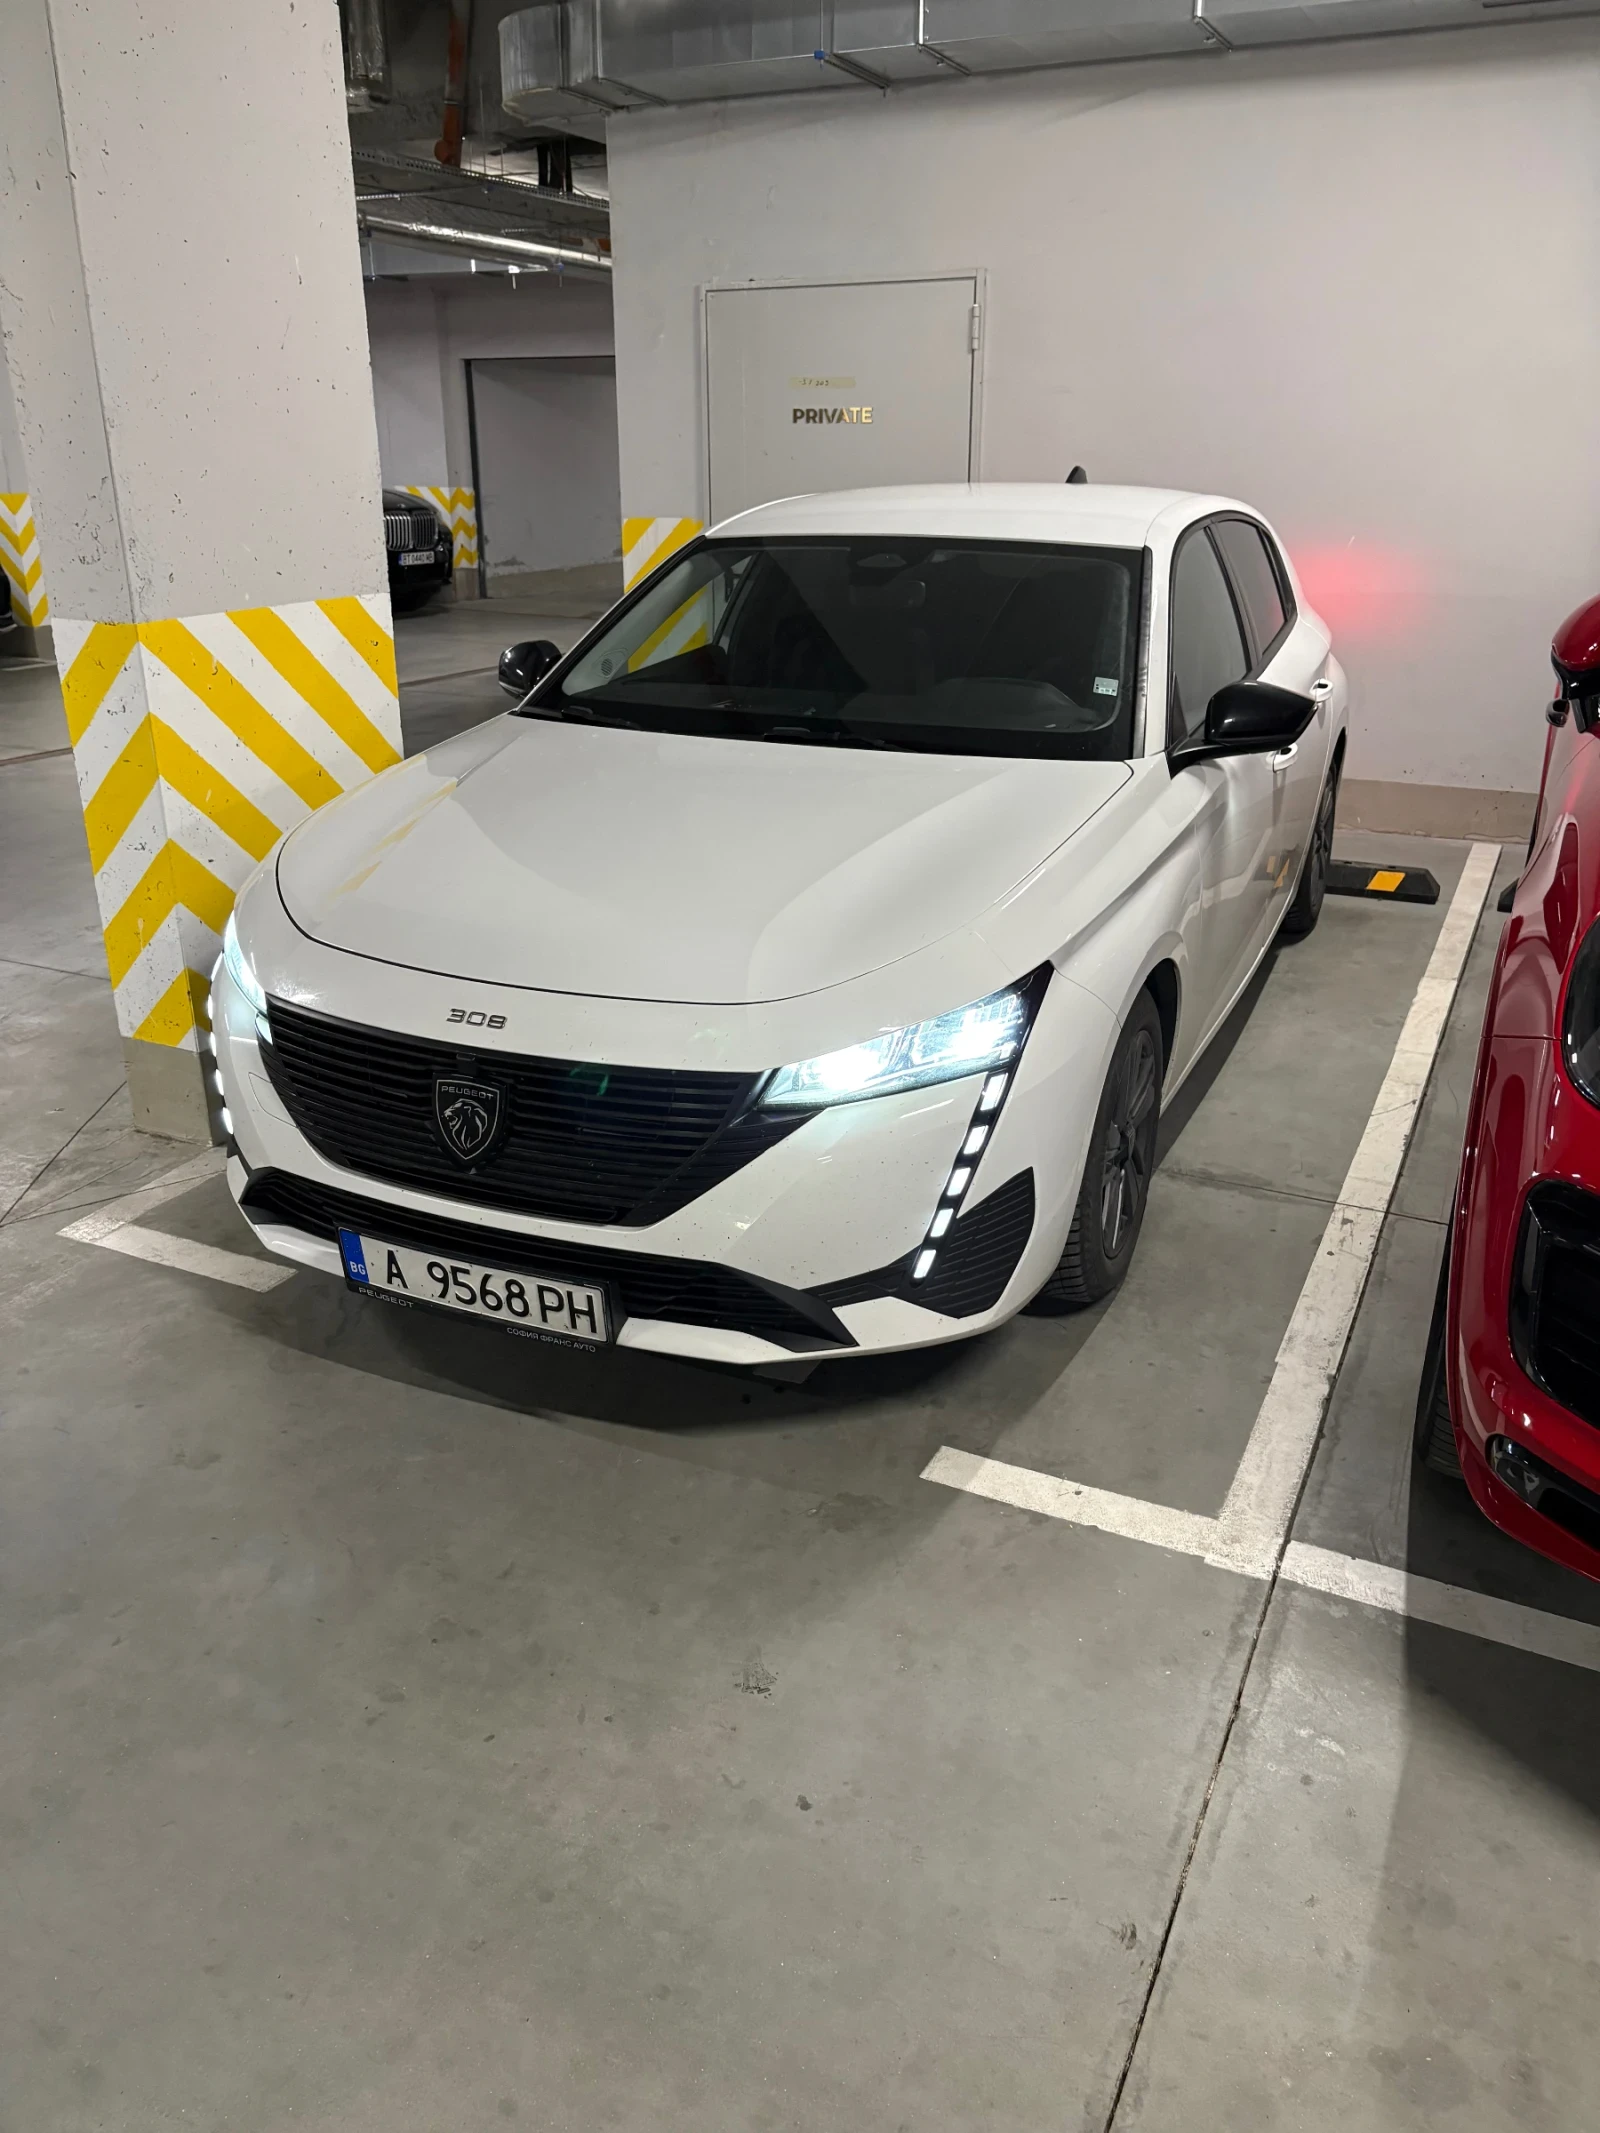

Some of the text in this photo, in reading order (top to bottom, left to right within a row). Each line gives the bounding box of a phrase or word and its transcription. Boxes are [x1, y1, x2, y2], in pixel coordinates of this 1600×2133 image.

[793, 407, 873, 424] PRIVATE
[446, 1008, 507, 1029] 308
[441, 1085, 494, 1101] PEUGEOT
[349, 1261, 367, 1276] BG
[358, 1287, 414, 1308] PEUGEOT
[386, 1249, 598, 1334] A 9568 PH
[506, 1327, 596, 1353] СОФИЯ ФРАНС АУТО
